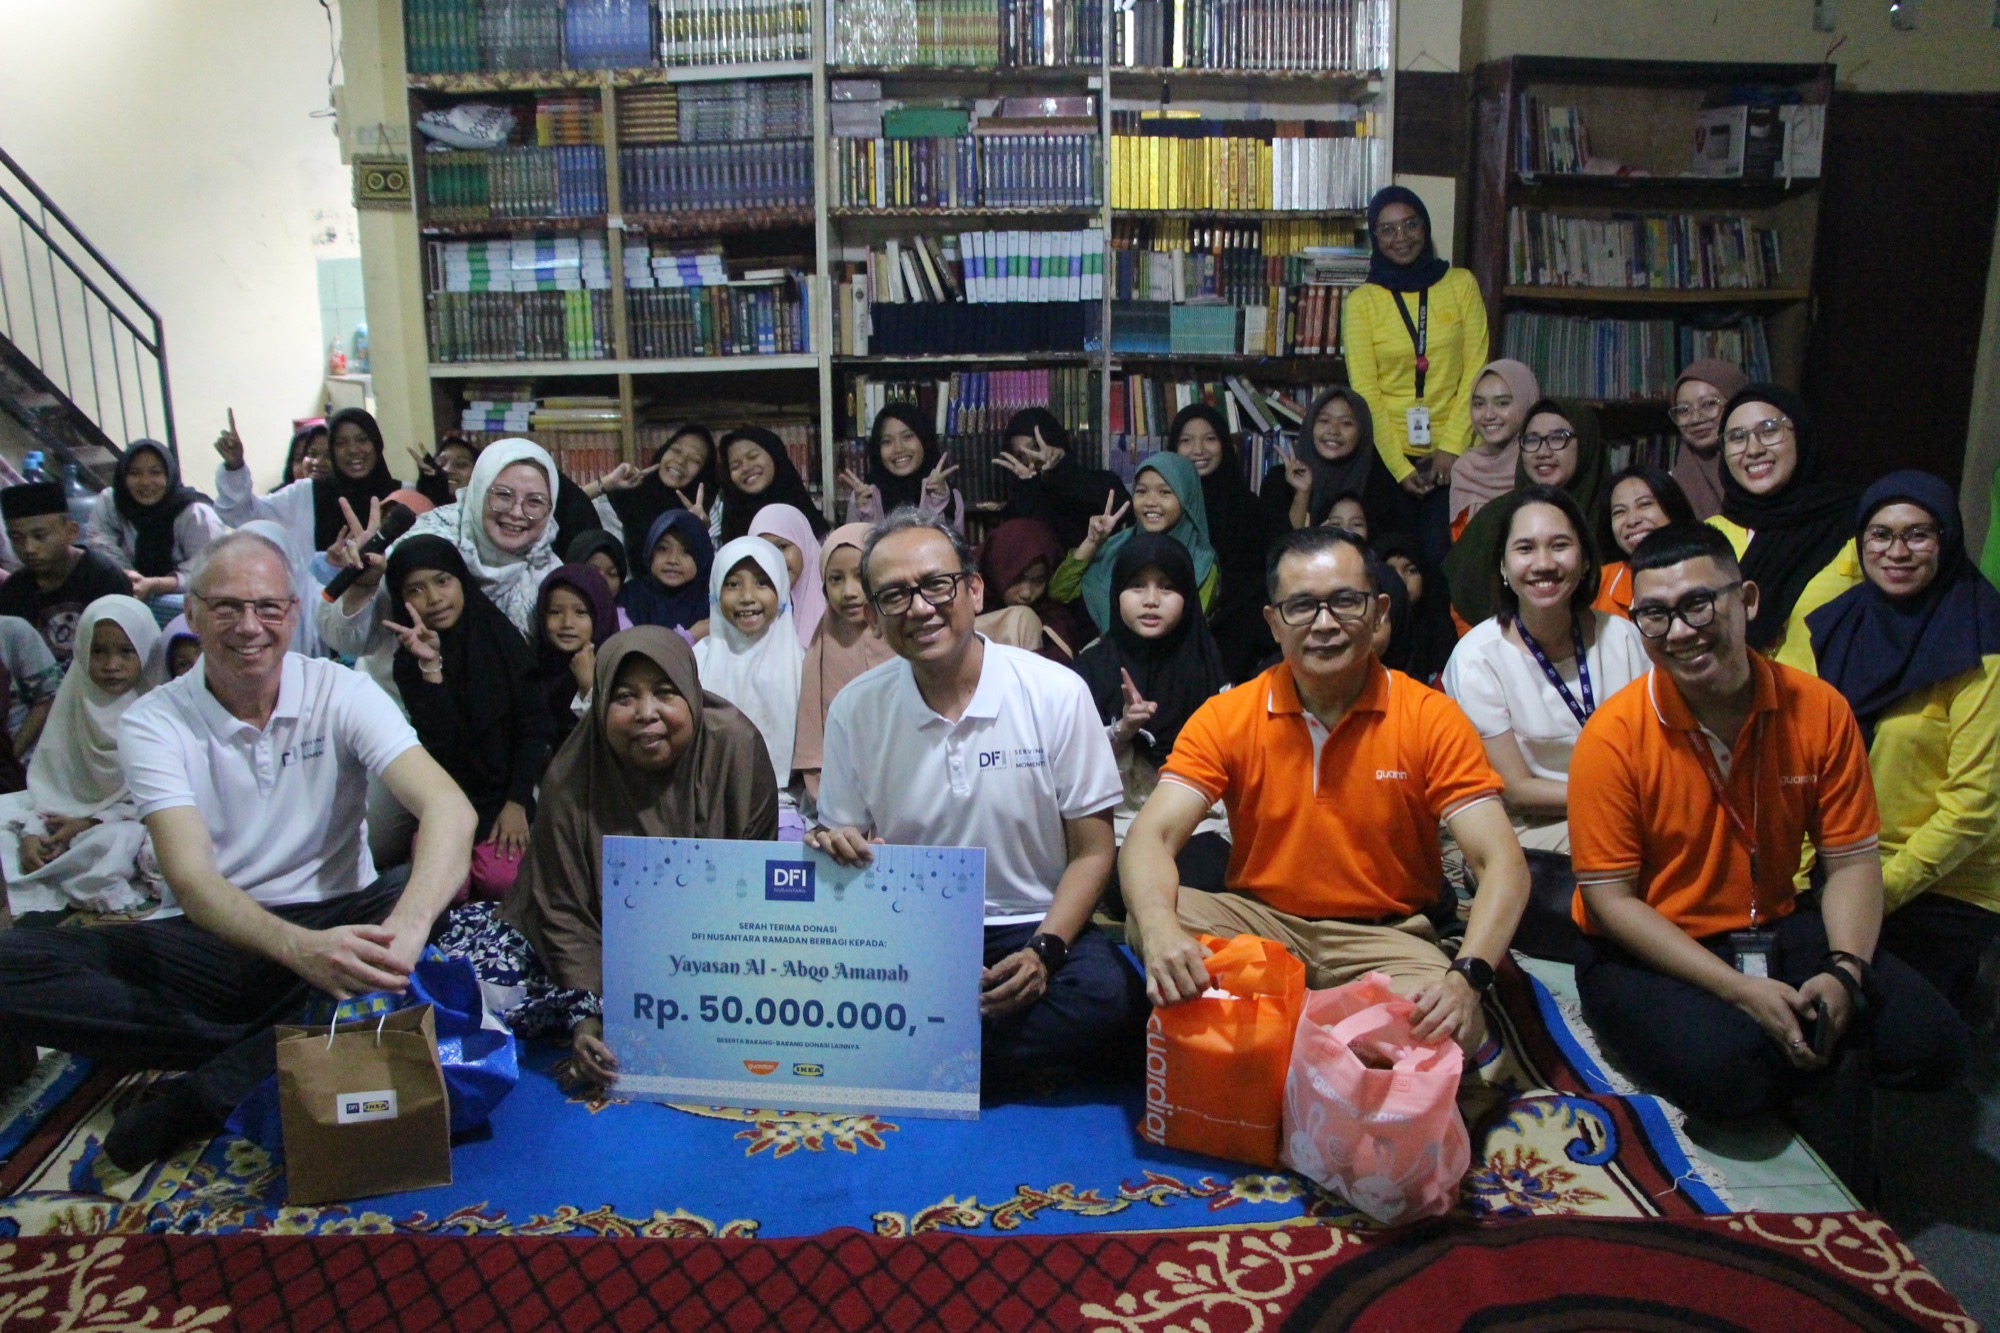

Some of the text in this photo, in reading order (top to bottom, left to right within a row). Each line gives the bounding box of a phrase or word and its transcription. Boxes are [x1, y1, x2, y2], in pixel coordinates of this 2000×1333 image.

[979, 750, 1007, 768] DFI
[774, 868, 807, 887] DFI
[739, 922, 837, 933] SERAH TERIMA DONASI
[691, 932, 705, 940] DFI
[707, 933, 761, 943] NUSANTARA
[762, 935, 808, 945] RAMADAN
[809, 937, 847, 946] BERBAGI
[668, 954, 740, 977] Yayasan
[743, 958, 766, 976] Al
[832, 962, 909, 983] Amanah
[337, 998, 387, 1019] KEA
[633, 992, 689, 1030] Rp.
[745, 1038, 803, 1048] BARANG-BARANG
[804, 1041, 830, 1049] DONASI
